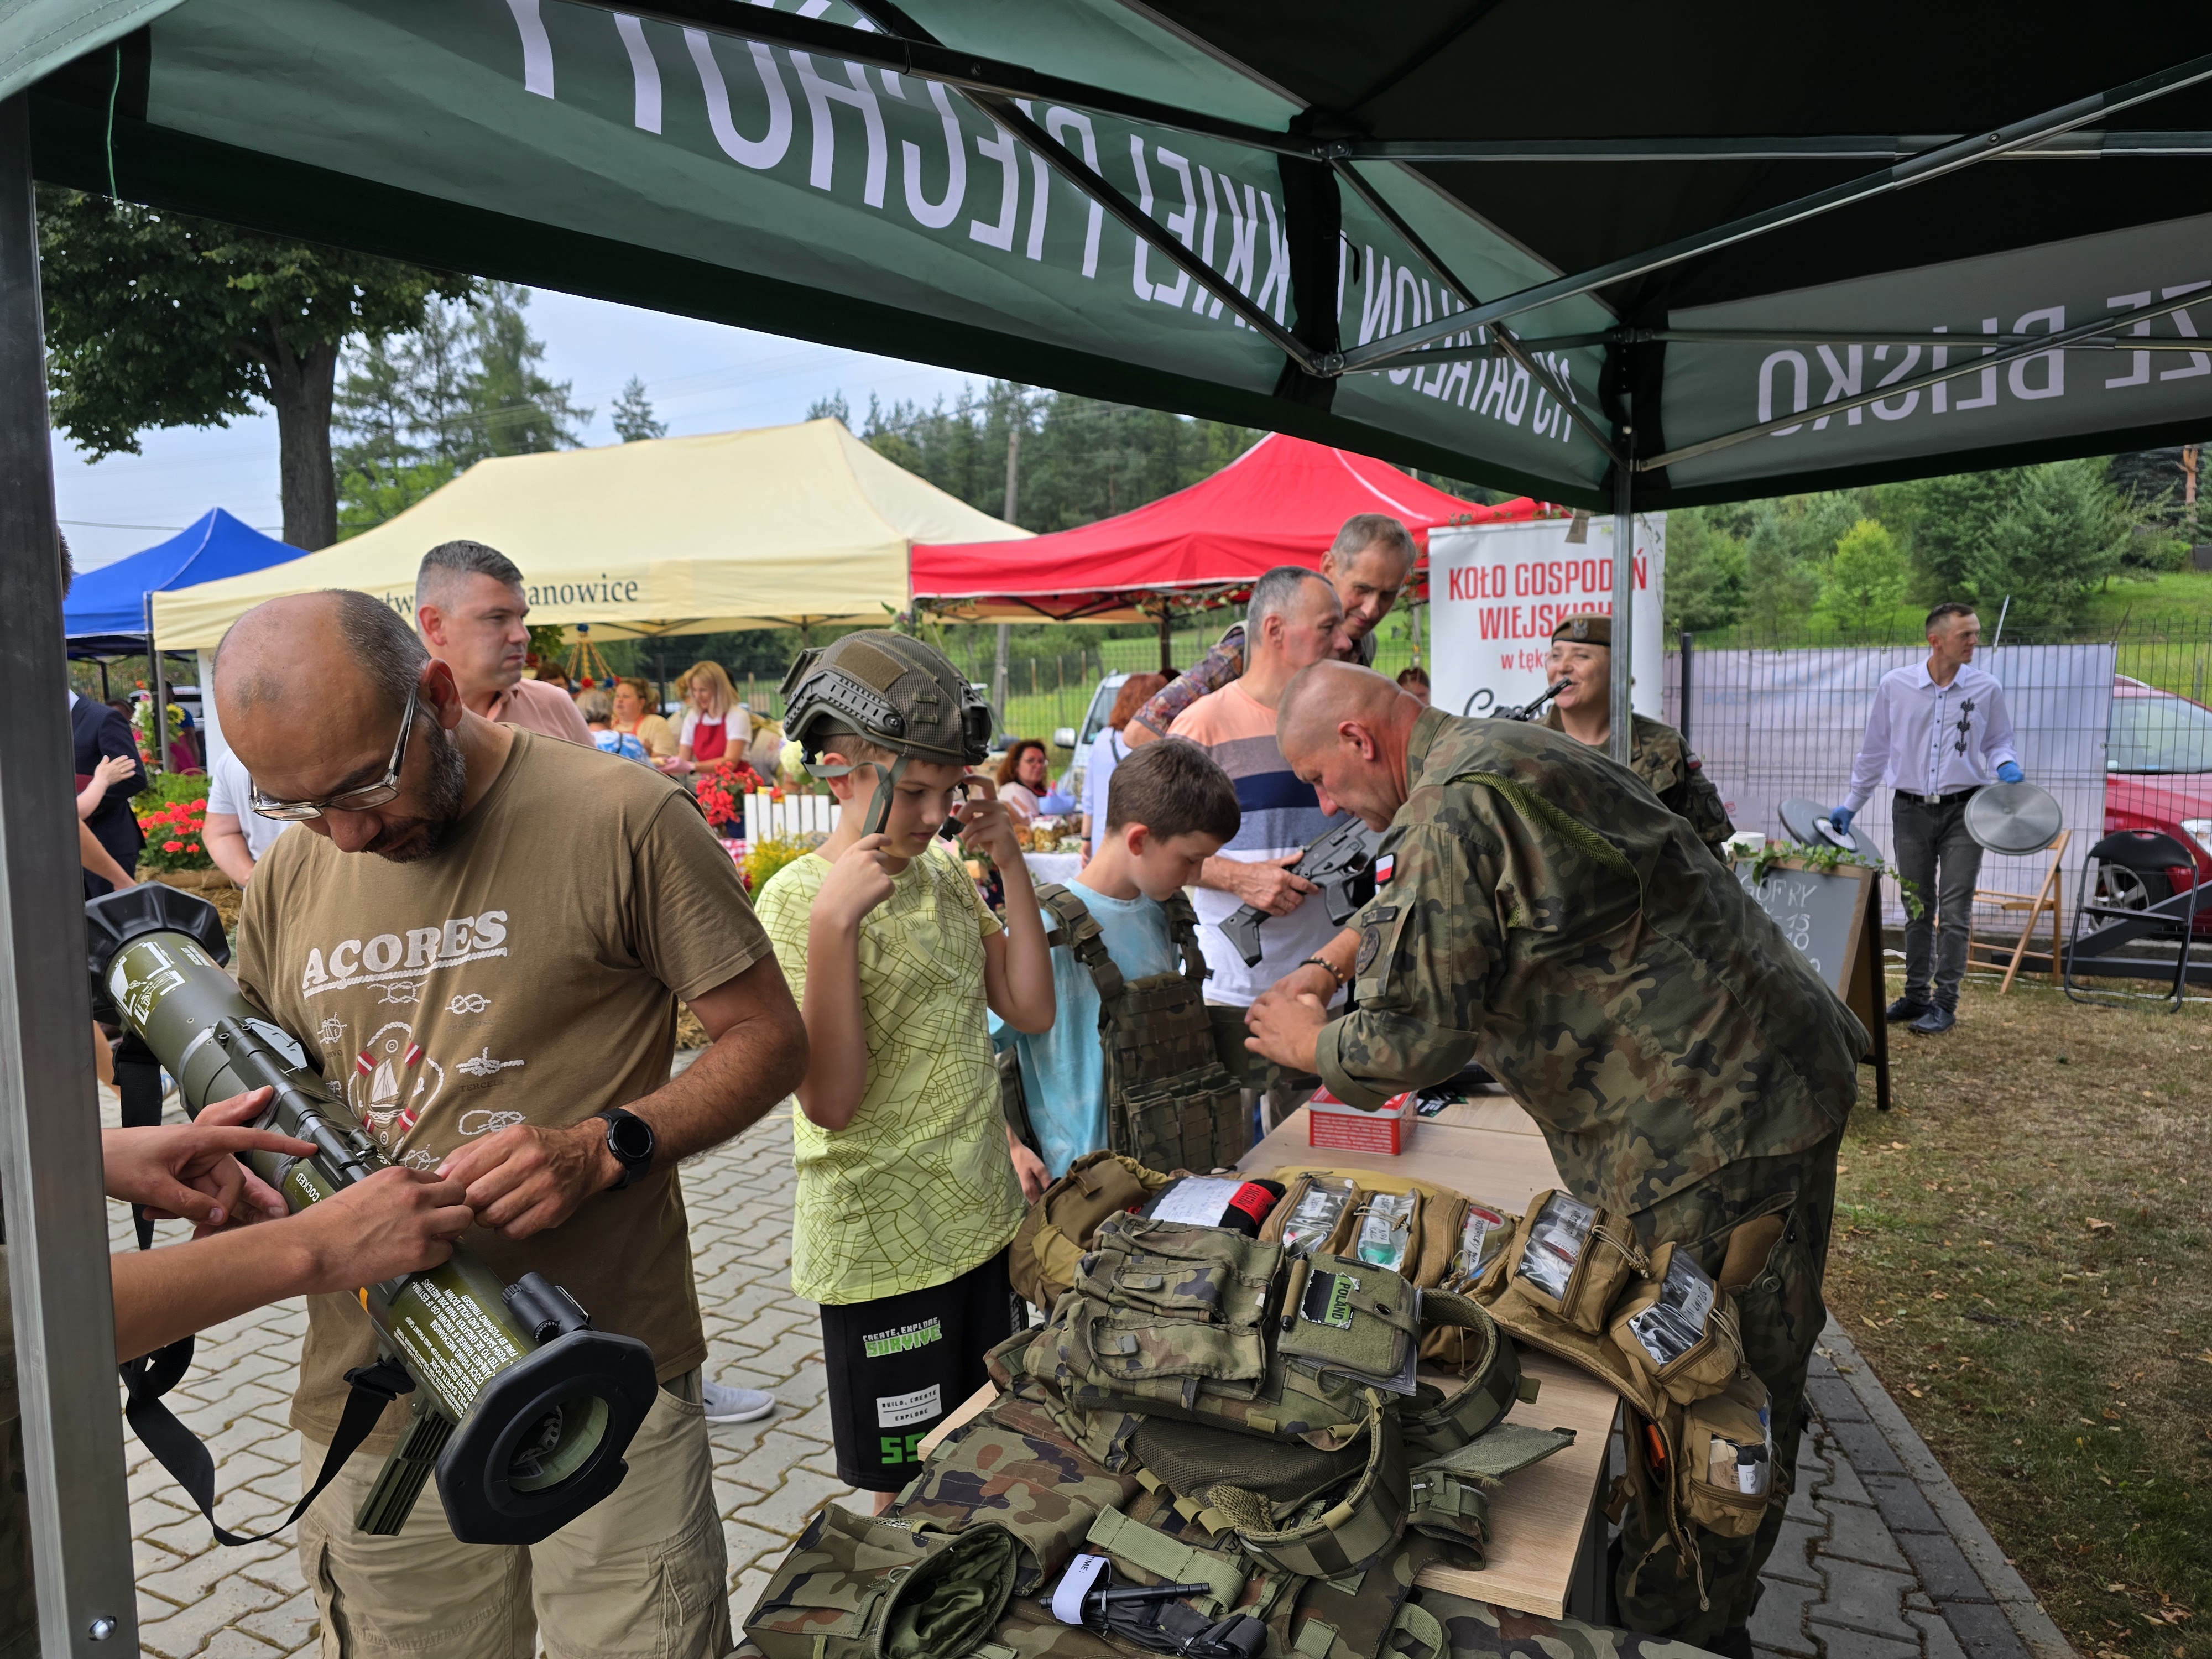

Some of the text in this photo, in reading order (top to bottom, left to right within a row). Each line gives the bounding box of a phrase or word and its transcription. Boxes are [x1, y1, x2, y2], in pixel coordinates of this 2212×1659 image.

[1449, 547, 1647, 601] KOŁO GOSPODŃ
[529, 572, 638, 605] anowice
[1501, 654, 1514, 669] w
[1741, 874, 1817, 907] GOFRY
[294, 1171, 321, 1202] COCKED
[1236, 1185, 1262, 1209] MEDIC
[411, 1281, 431, 1303] ESTIMA-
[425, 1298, 435, 1308] IF
[1331, 1282, 1351, 1320] POLAND
[429, 1303, 441, 1316] OR
[412, 1324, 425, 1341] FRONT
[420, 1277, 500, 1370] TED TO BE GREATER THAN 200 METERS
[436, 1311, 457, 1334] KNOWN
[442, 1288, 510, 1363] PUSH SAFETY AND HOLD DOWN
[451, 1329, 461, 1339] IF
[460, 1294, 519, 1358] FIRE BY PUSHING TRIGGER
[423, 1337, 433, 1349] AND
[455, 1334, 476, 1357] RANGE
[862, 1328, 900, 1342] CREATE,
[865, 1323, 942, 1358] SURVIVE
[429, 1318, 485, 1385] COCK FIRING MECHANISM
[430, 1347, 441, 1360] STOP
[439, 1355, 458, 1382] SHOULDER
[448, 1358, 478, 1395] RELEASE SIGHTS
[429, 1357, 469, 1410] PULL SAFETY FORK
[455, 1378, 465, 1390] OUT
[462, 1386, 474, 1402] FOLD
[910, 1390, 937, 1404] CREATE
[895, 1408, 928, 1421] EXPLORE
[1078, 1556, 1094, 1573] TIME:
